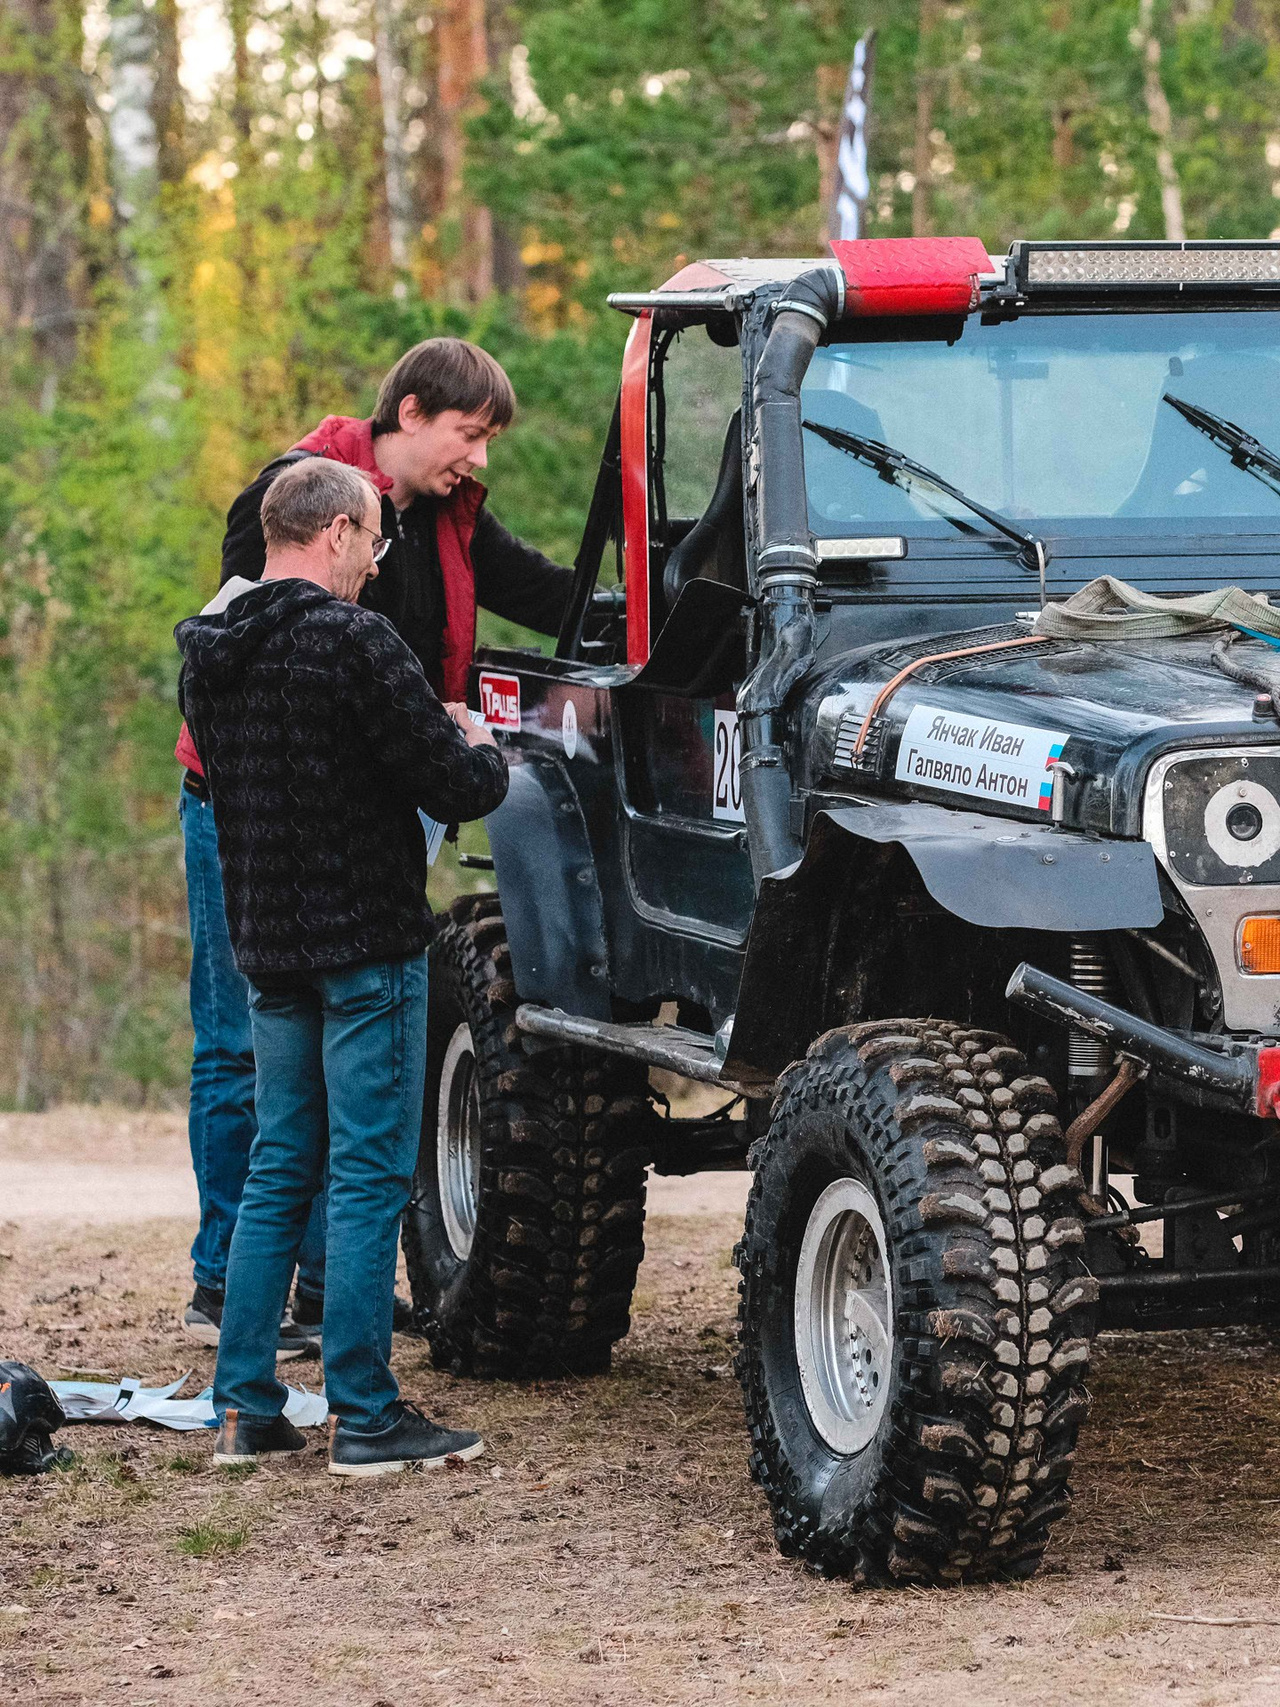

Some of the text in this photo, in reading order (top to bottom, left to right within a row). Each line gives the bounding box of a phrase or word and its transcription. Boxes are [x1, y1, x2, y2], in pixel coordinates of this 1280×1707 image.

[927, 715, 1025, 757] Янчак Иван
[906, 748, 1029, 798] Галвяло Антон
